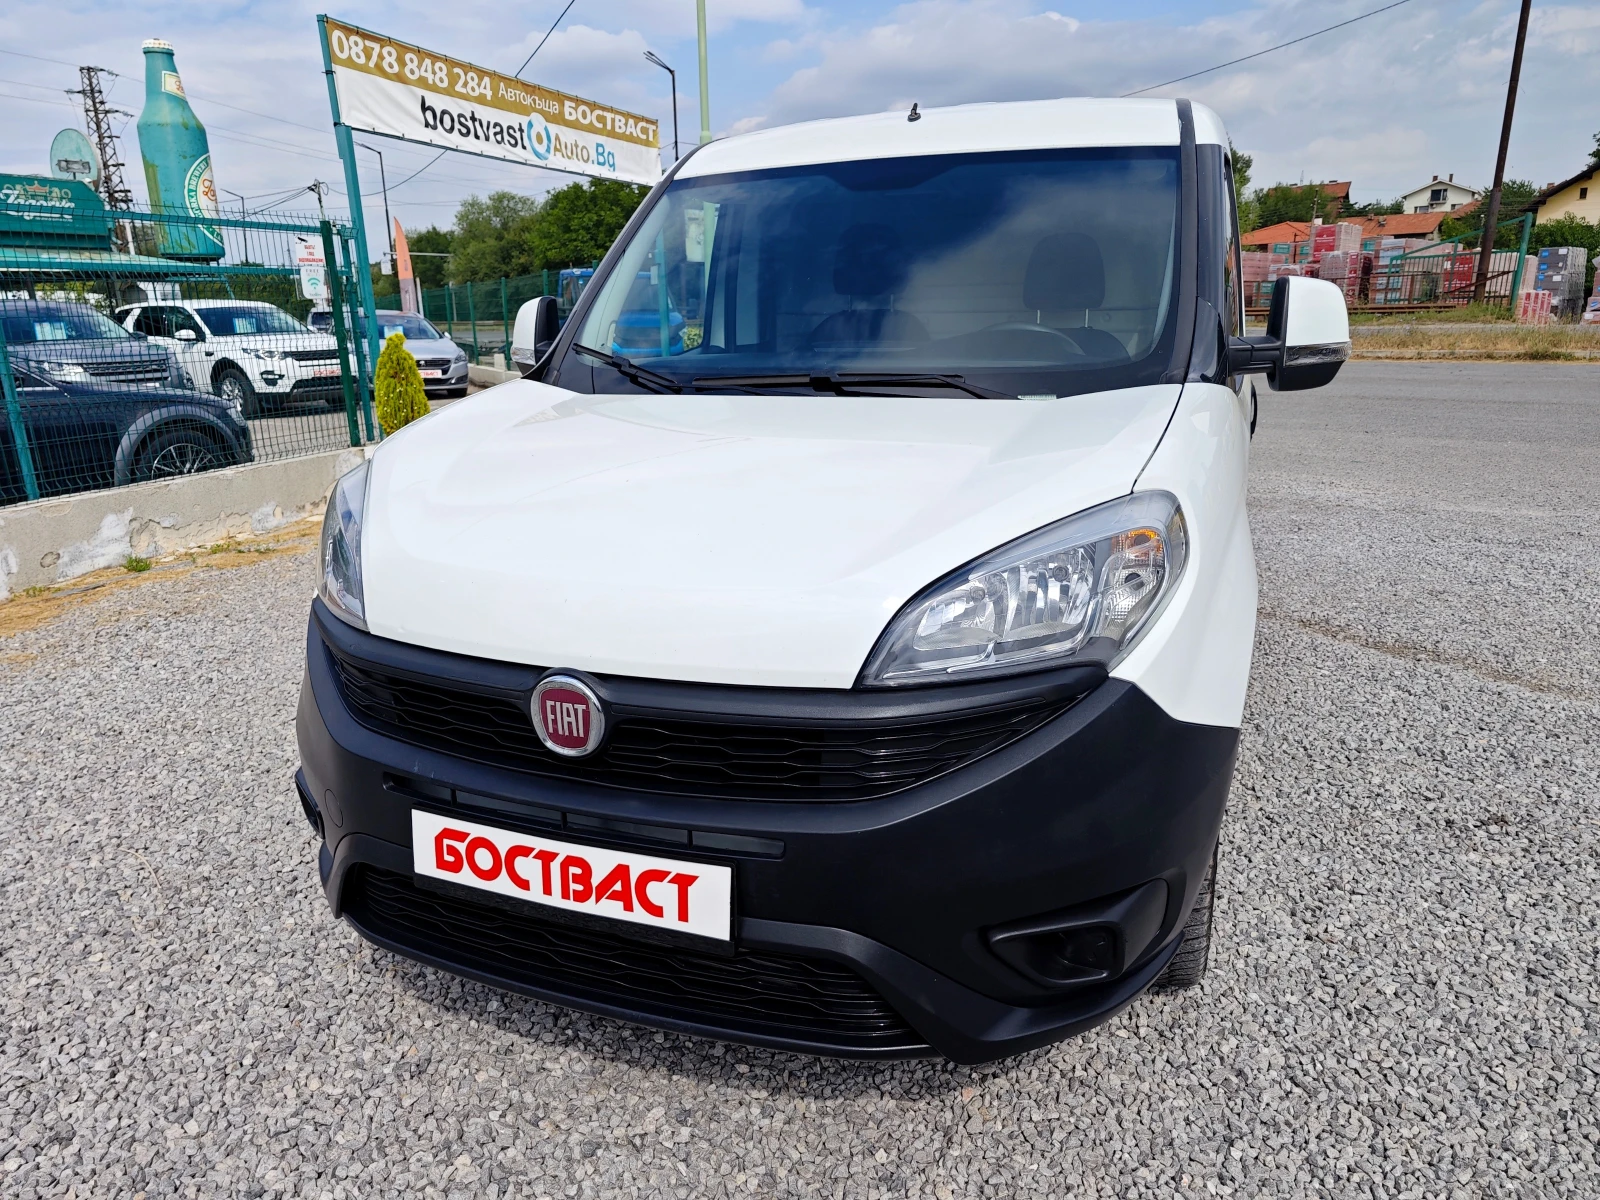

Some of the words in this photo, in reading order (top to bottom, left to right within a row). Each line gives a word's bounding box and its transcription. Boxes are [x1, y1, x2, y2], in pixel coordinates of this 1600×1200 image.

[331, 29, 400, 74] 0878
[404, 52, 449, 89] 848
[453, 67, 493, 101] 284
[563, 100, 657, 142] БОСТВАСТ
[545, 699, 588, 738] FIAT
[434, 827, 700, 923] БОСТВАСТ
